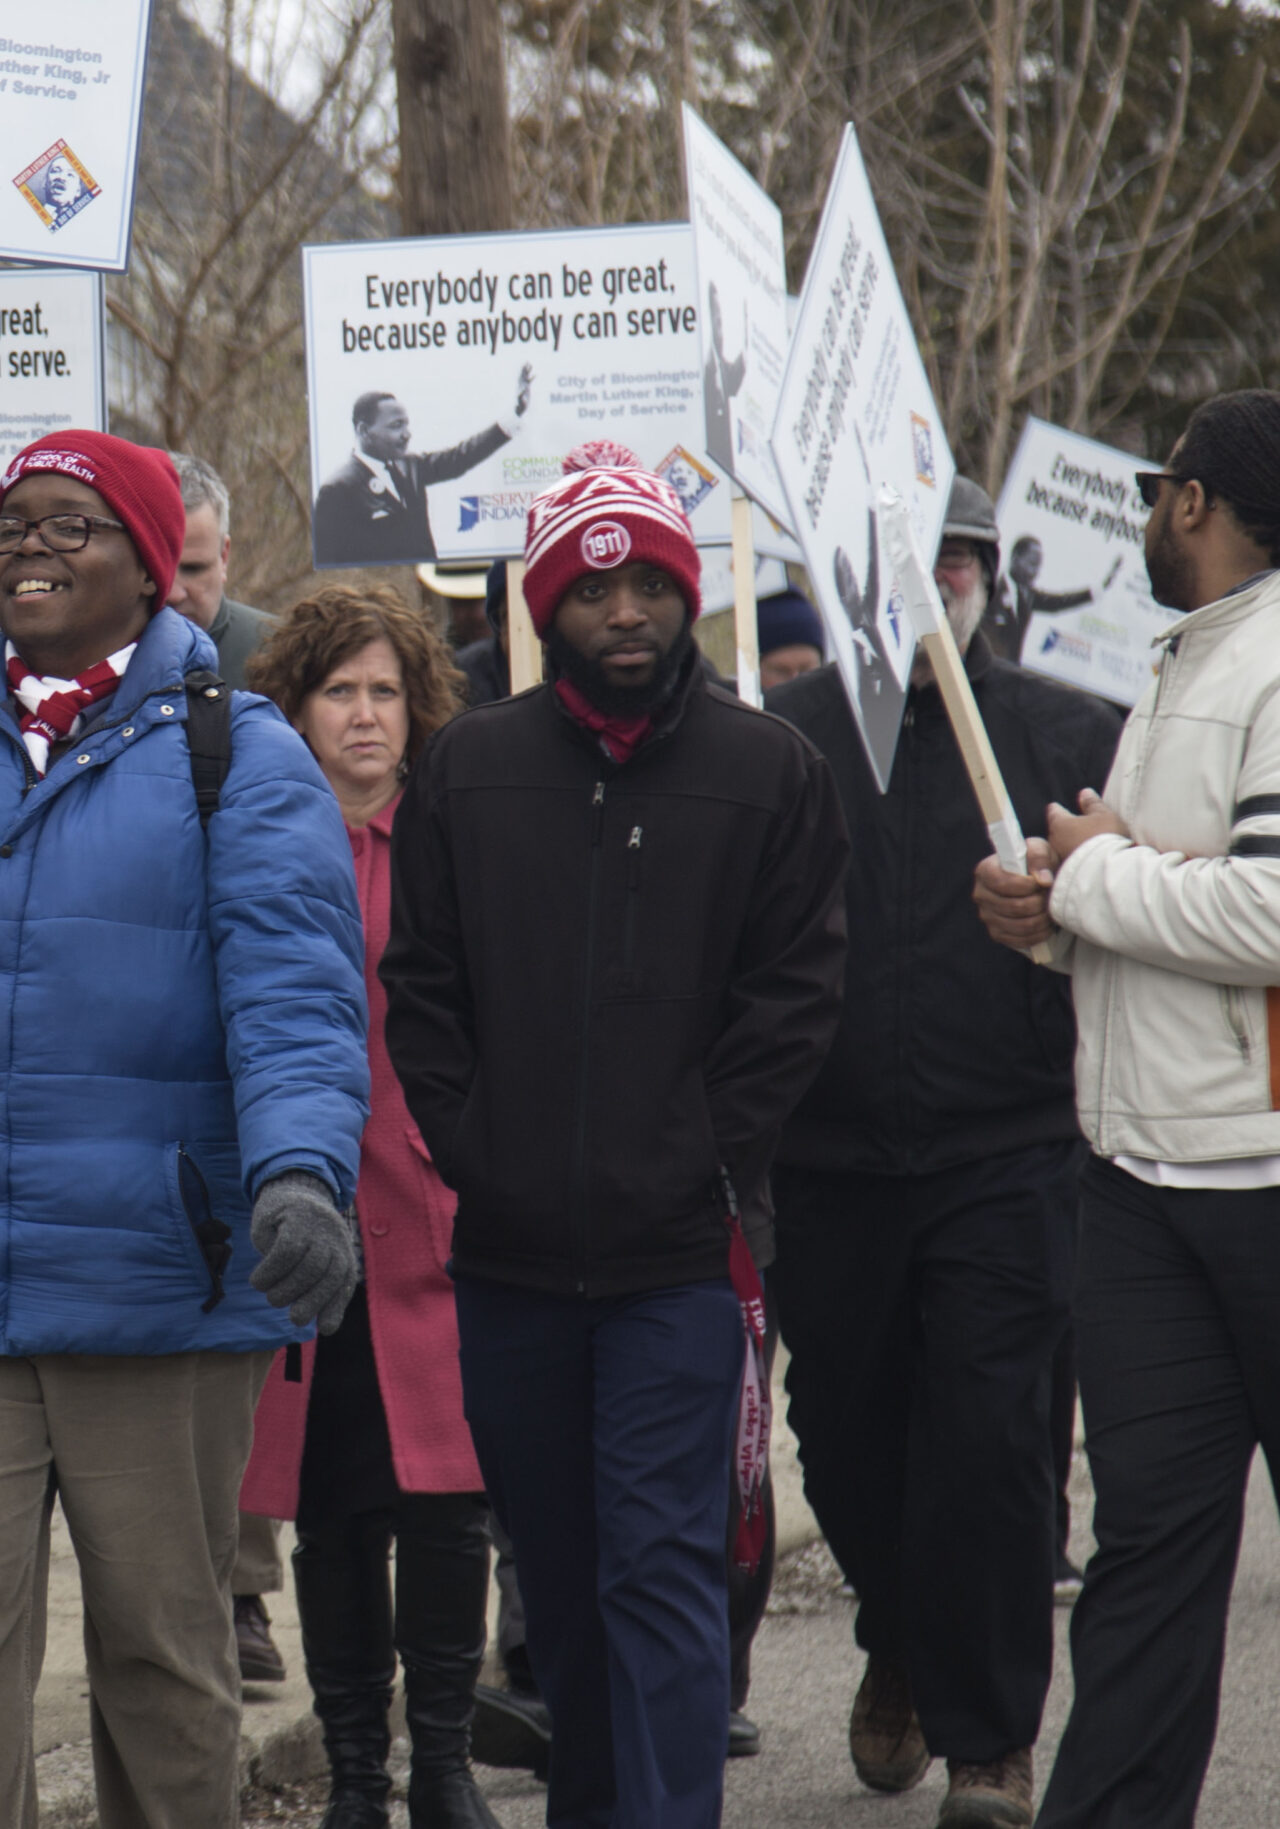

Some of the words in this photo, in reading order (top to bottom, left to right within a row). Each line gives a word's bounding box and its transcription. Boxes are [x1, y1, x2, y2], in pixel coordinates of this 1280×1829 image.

[44, 63, 87, 85] King,
[92, 70, 111, 84] Jr
[13, 80, 77, 100] Service
[366, 268, 498, 317] Everybody
[508, 272, 552, 301] can
[562, 263, 592, 298] be
[602, 257, 676, 306] great,
[342, 317, 447, 353] because
[457, 307, 562, 355] anybody
[573, 310, 618, 340] can
[627, 305, 696, 336] serve
[8, 350, 71, 378] serve.
[557, 375, 587, 389] City
[591, 373, 606, 386] of
[549, 391, 598, 404] Martin
[602, 389, 650, 401] Luther
[577, 407, 606, 420] Day
[610, 405, 625, 417] of
[630, 403, 687, 416] Service
[28, 453, 63, 463] SCHOOL
[503, 455, 563, 470] COMMUN
[57, 461, 96, 482] HEALTH
[503, 467, 561, 479] FOUNDA
[481, 505, 528, 520] INDIAN
[586, 531, 622, 558] 1911
